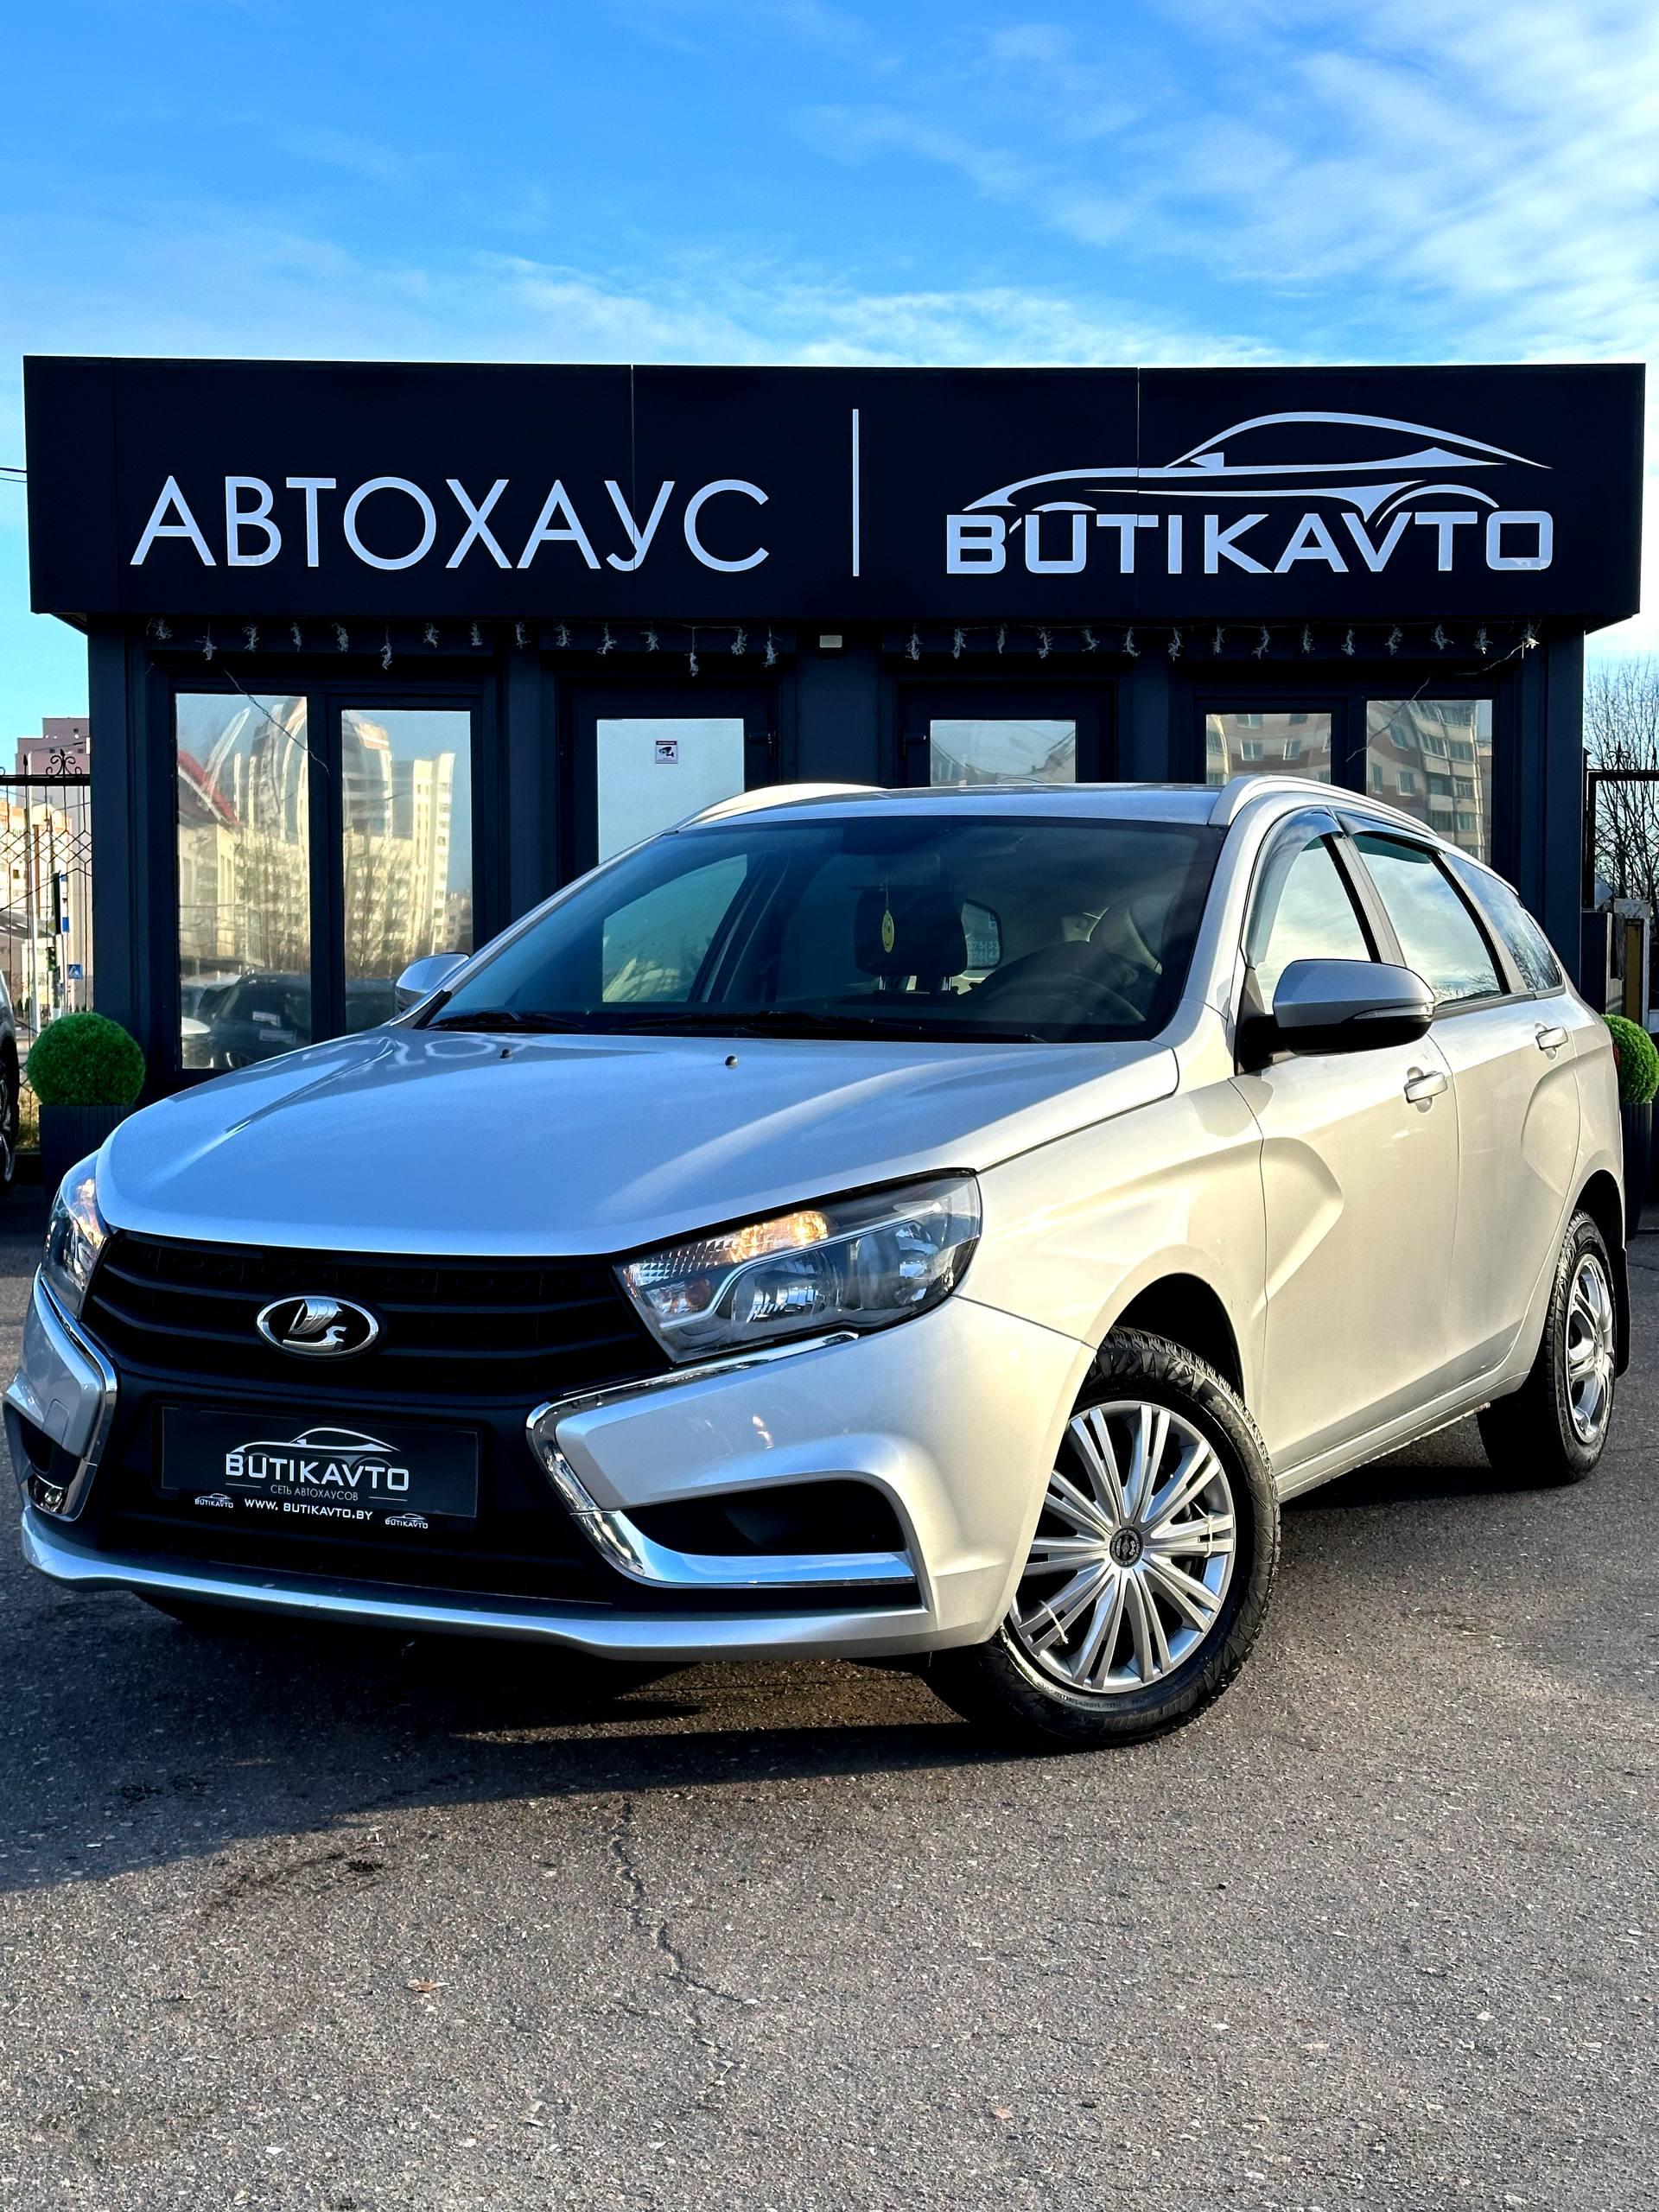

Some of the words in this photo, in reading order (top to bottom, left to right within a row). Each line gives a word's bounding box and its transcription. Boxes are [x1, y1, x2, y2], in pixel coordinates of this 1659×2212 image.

[130, 476, 770, 572] АВТОХАУС
[947, 510, 1554, 575] BUTIKAVTO
[226, 1453, 410, 1491] BUTIKAVTO
[270, 1484, 292, 1495] СЕТЬ
[294, 1488, 359, 1501] АВТОХАУСОВ
